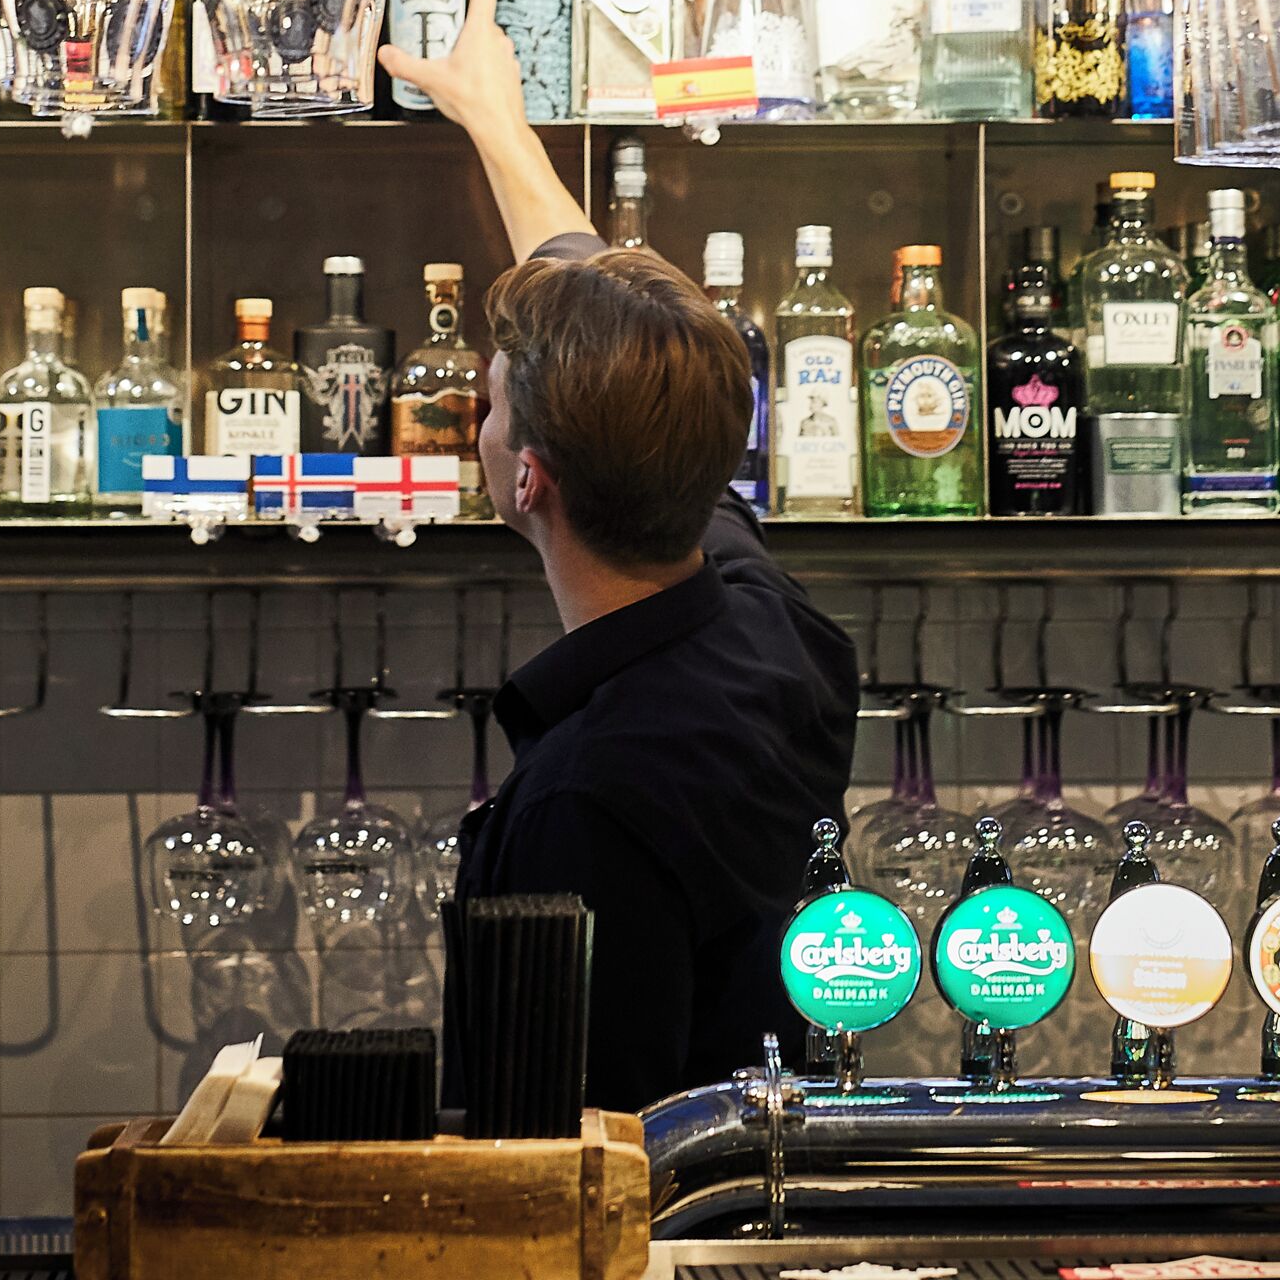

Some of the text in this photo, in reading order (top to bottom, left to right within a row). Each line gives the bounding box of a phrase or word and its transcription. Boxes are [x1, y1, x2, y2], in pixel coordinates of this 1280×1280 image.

[1113, 310, 1171, 327] OXLEY
[805, 355, 833, 367] OLD
[888, 360, 966, 411] PLYMOUTH GIN
[217, 391, 287, 416] GIN
[994, 406, 1077, 438] MOM
[790, 932, 912, 982] Carlsberg
[946, 928, 1067, 979] Carlsberg
[812, 987, 888, 1000] DANMARK
[970, 983, 1045, 996] DANMARK
